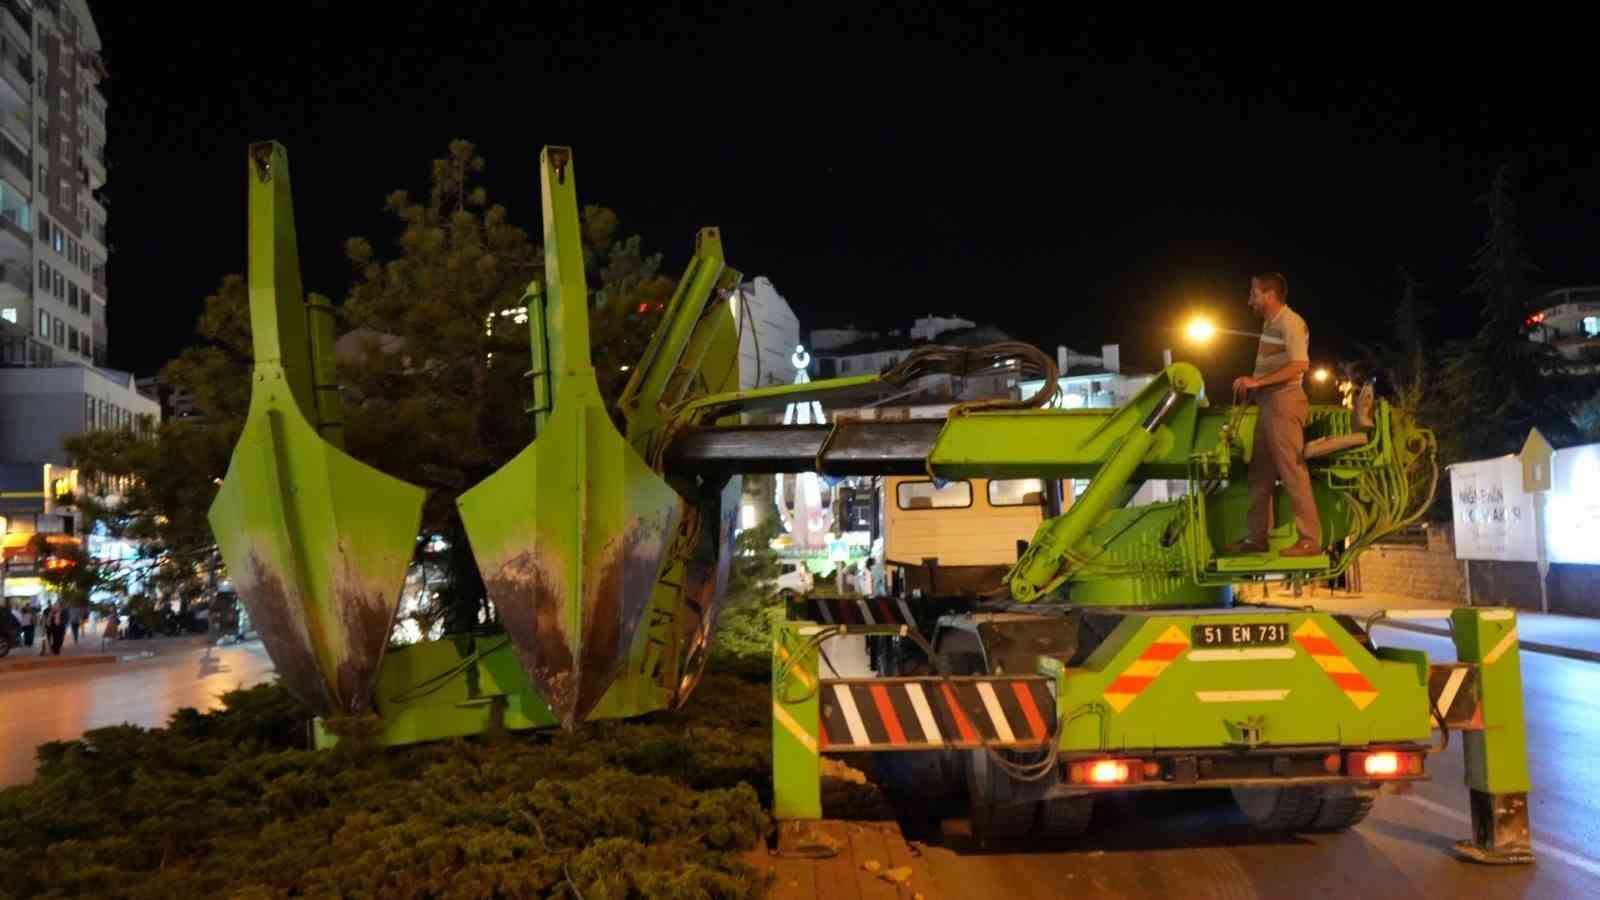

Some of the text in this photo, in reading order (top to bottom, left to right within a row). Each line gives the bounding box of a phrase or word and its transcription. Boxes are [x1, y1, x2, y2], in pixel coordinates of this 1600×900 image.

[1204, 625, 1285, 643] 51 EN 731
